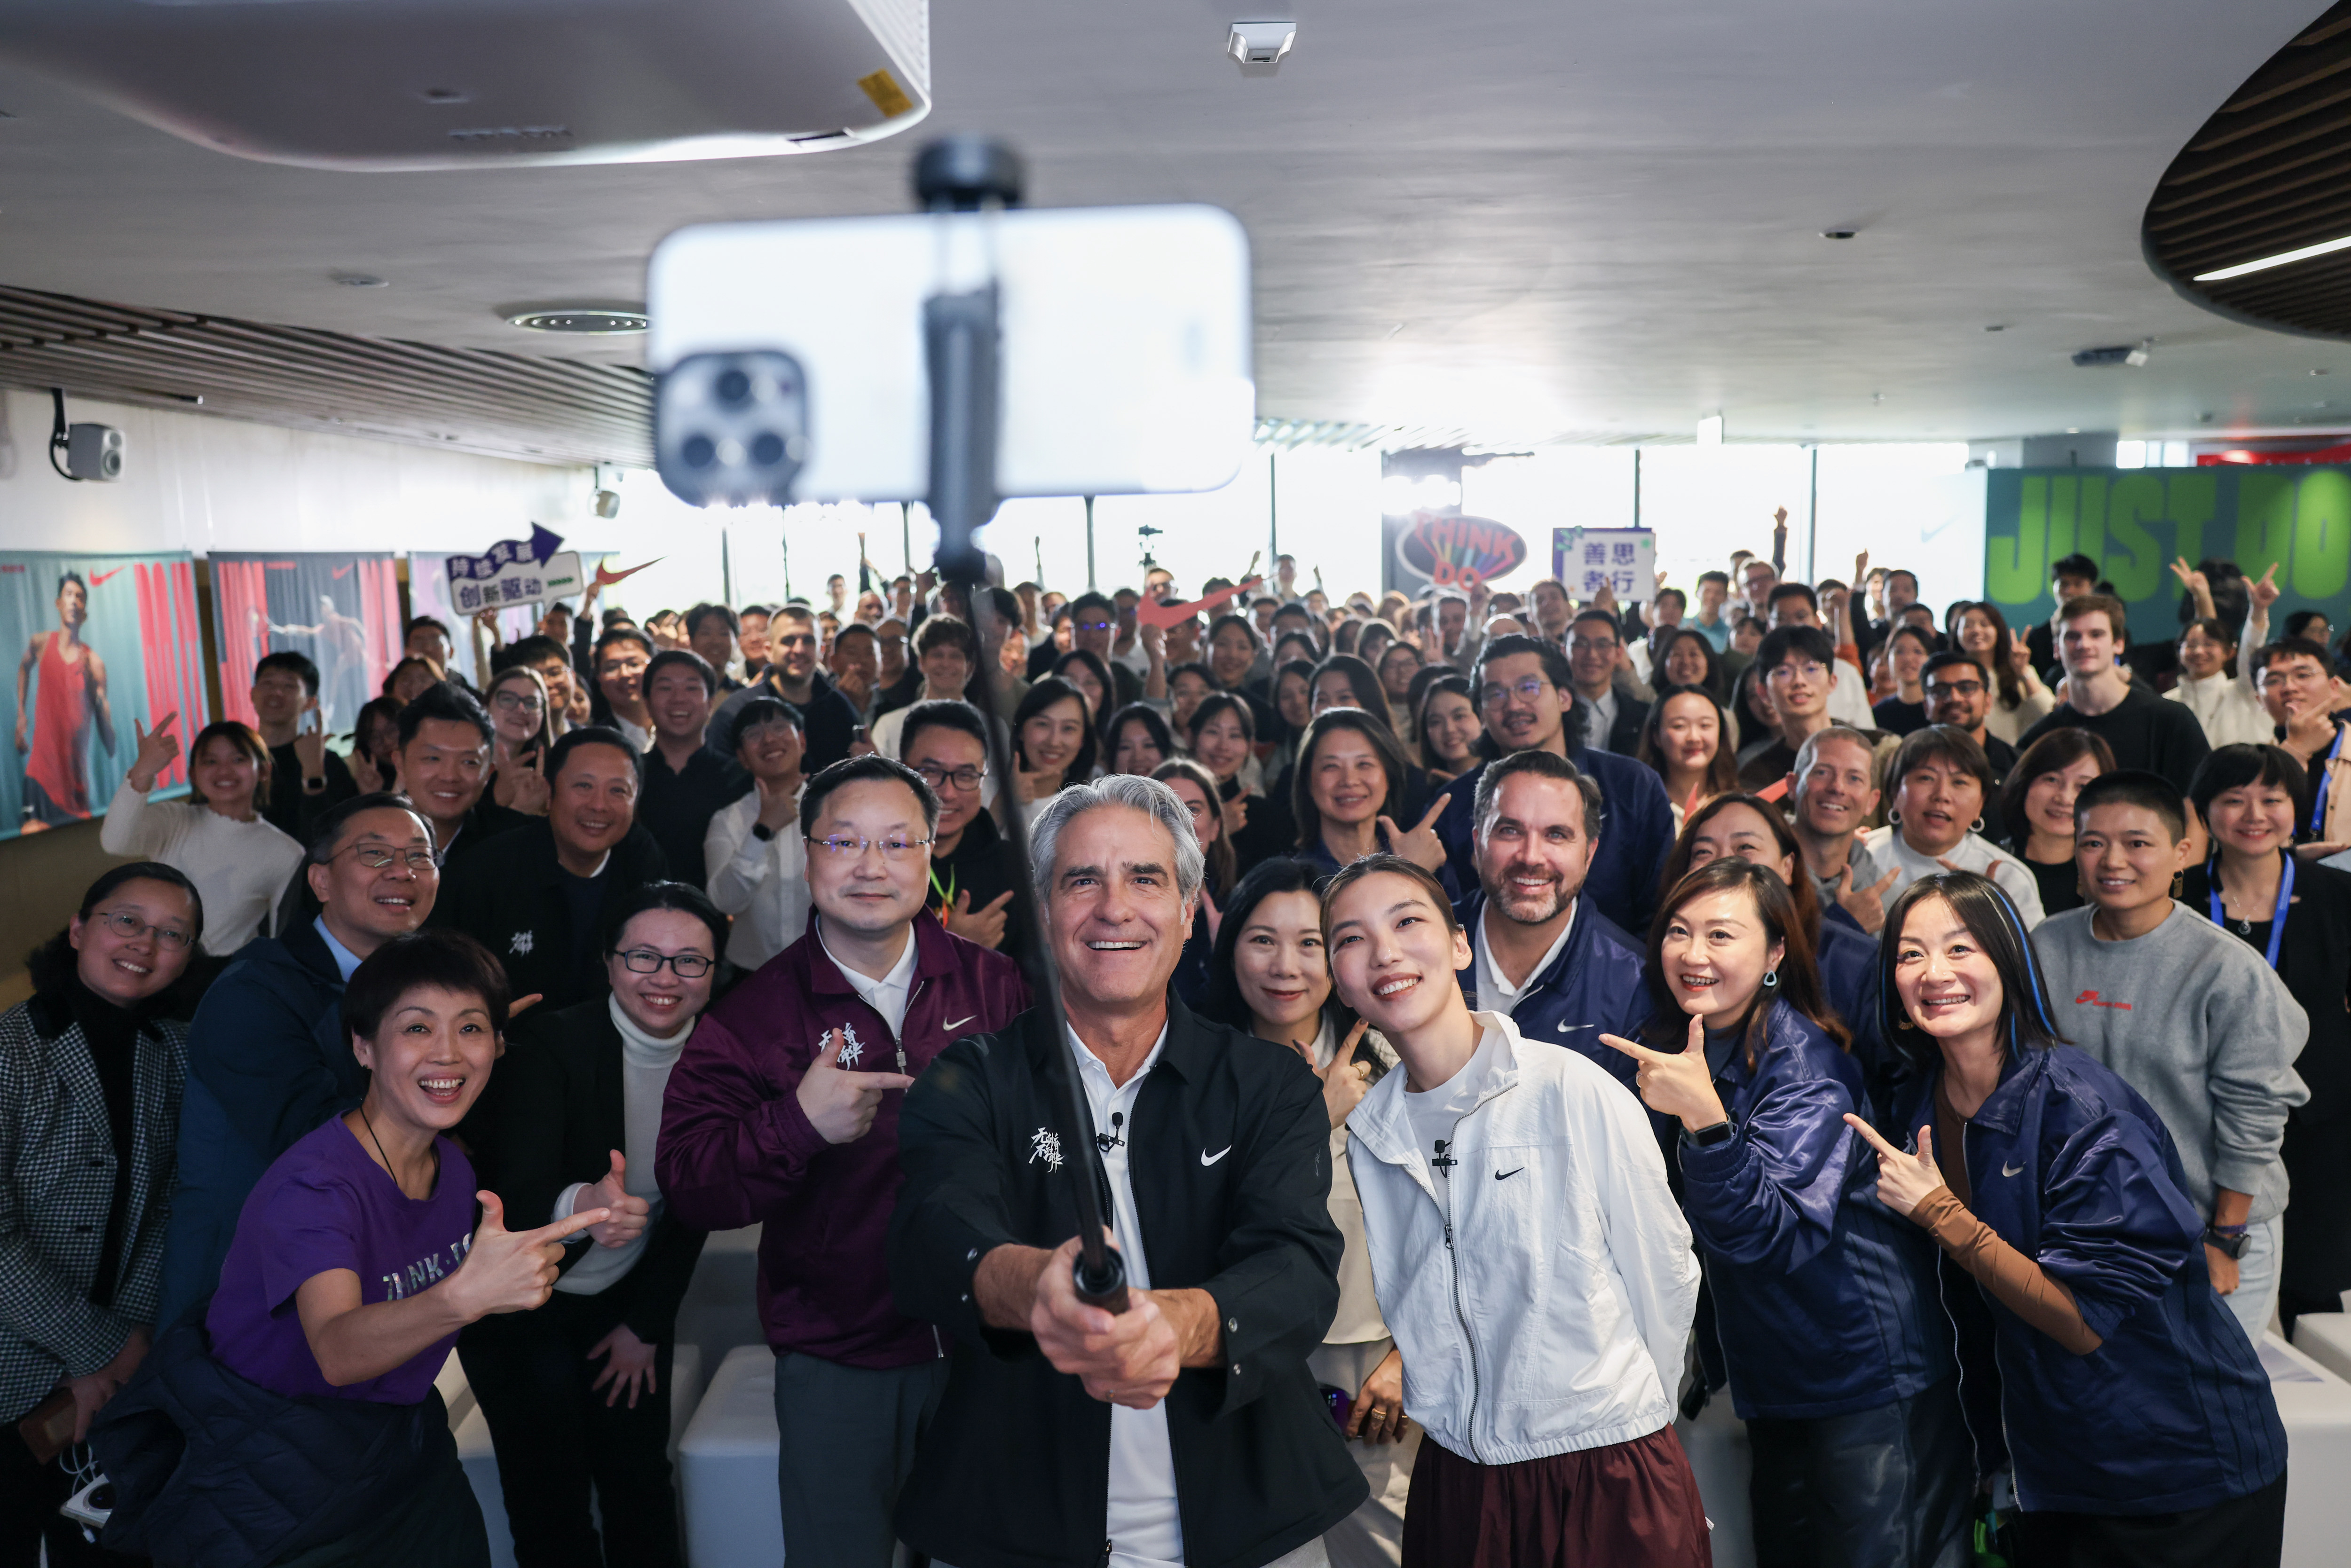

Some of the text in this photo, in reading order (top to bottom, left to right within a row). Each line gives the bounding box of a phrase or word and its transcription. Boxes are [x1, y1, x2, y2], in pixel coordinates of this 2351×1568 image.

[1414, 512, 1518, 562] THINK
[1584, 542, 1635, 566] 善思
[1988, 470, 2351, 604] JUST DO
[1435, 559, 1482, 594] DO
